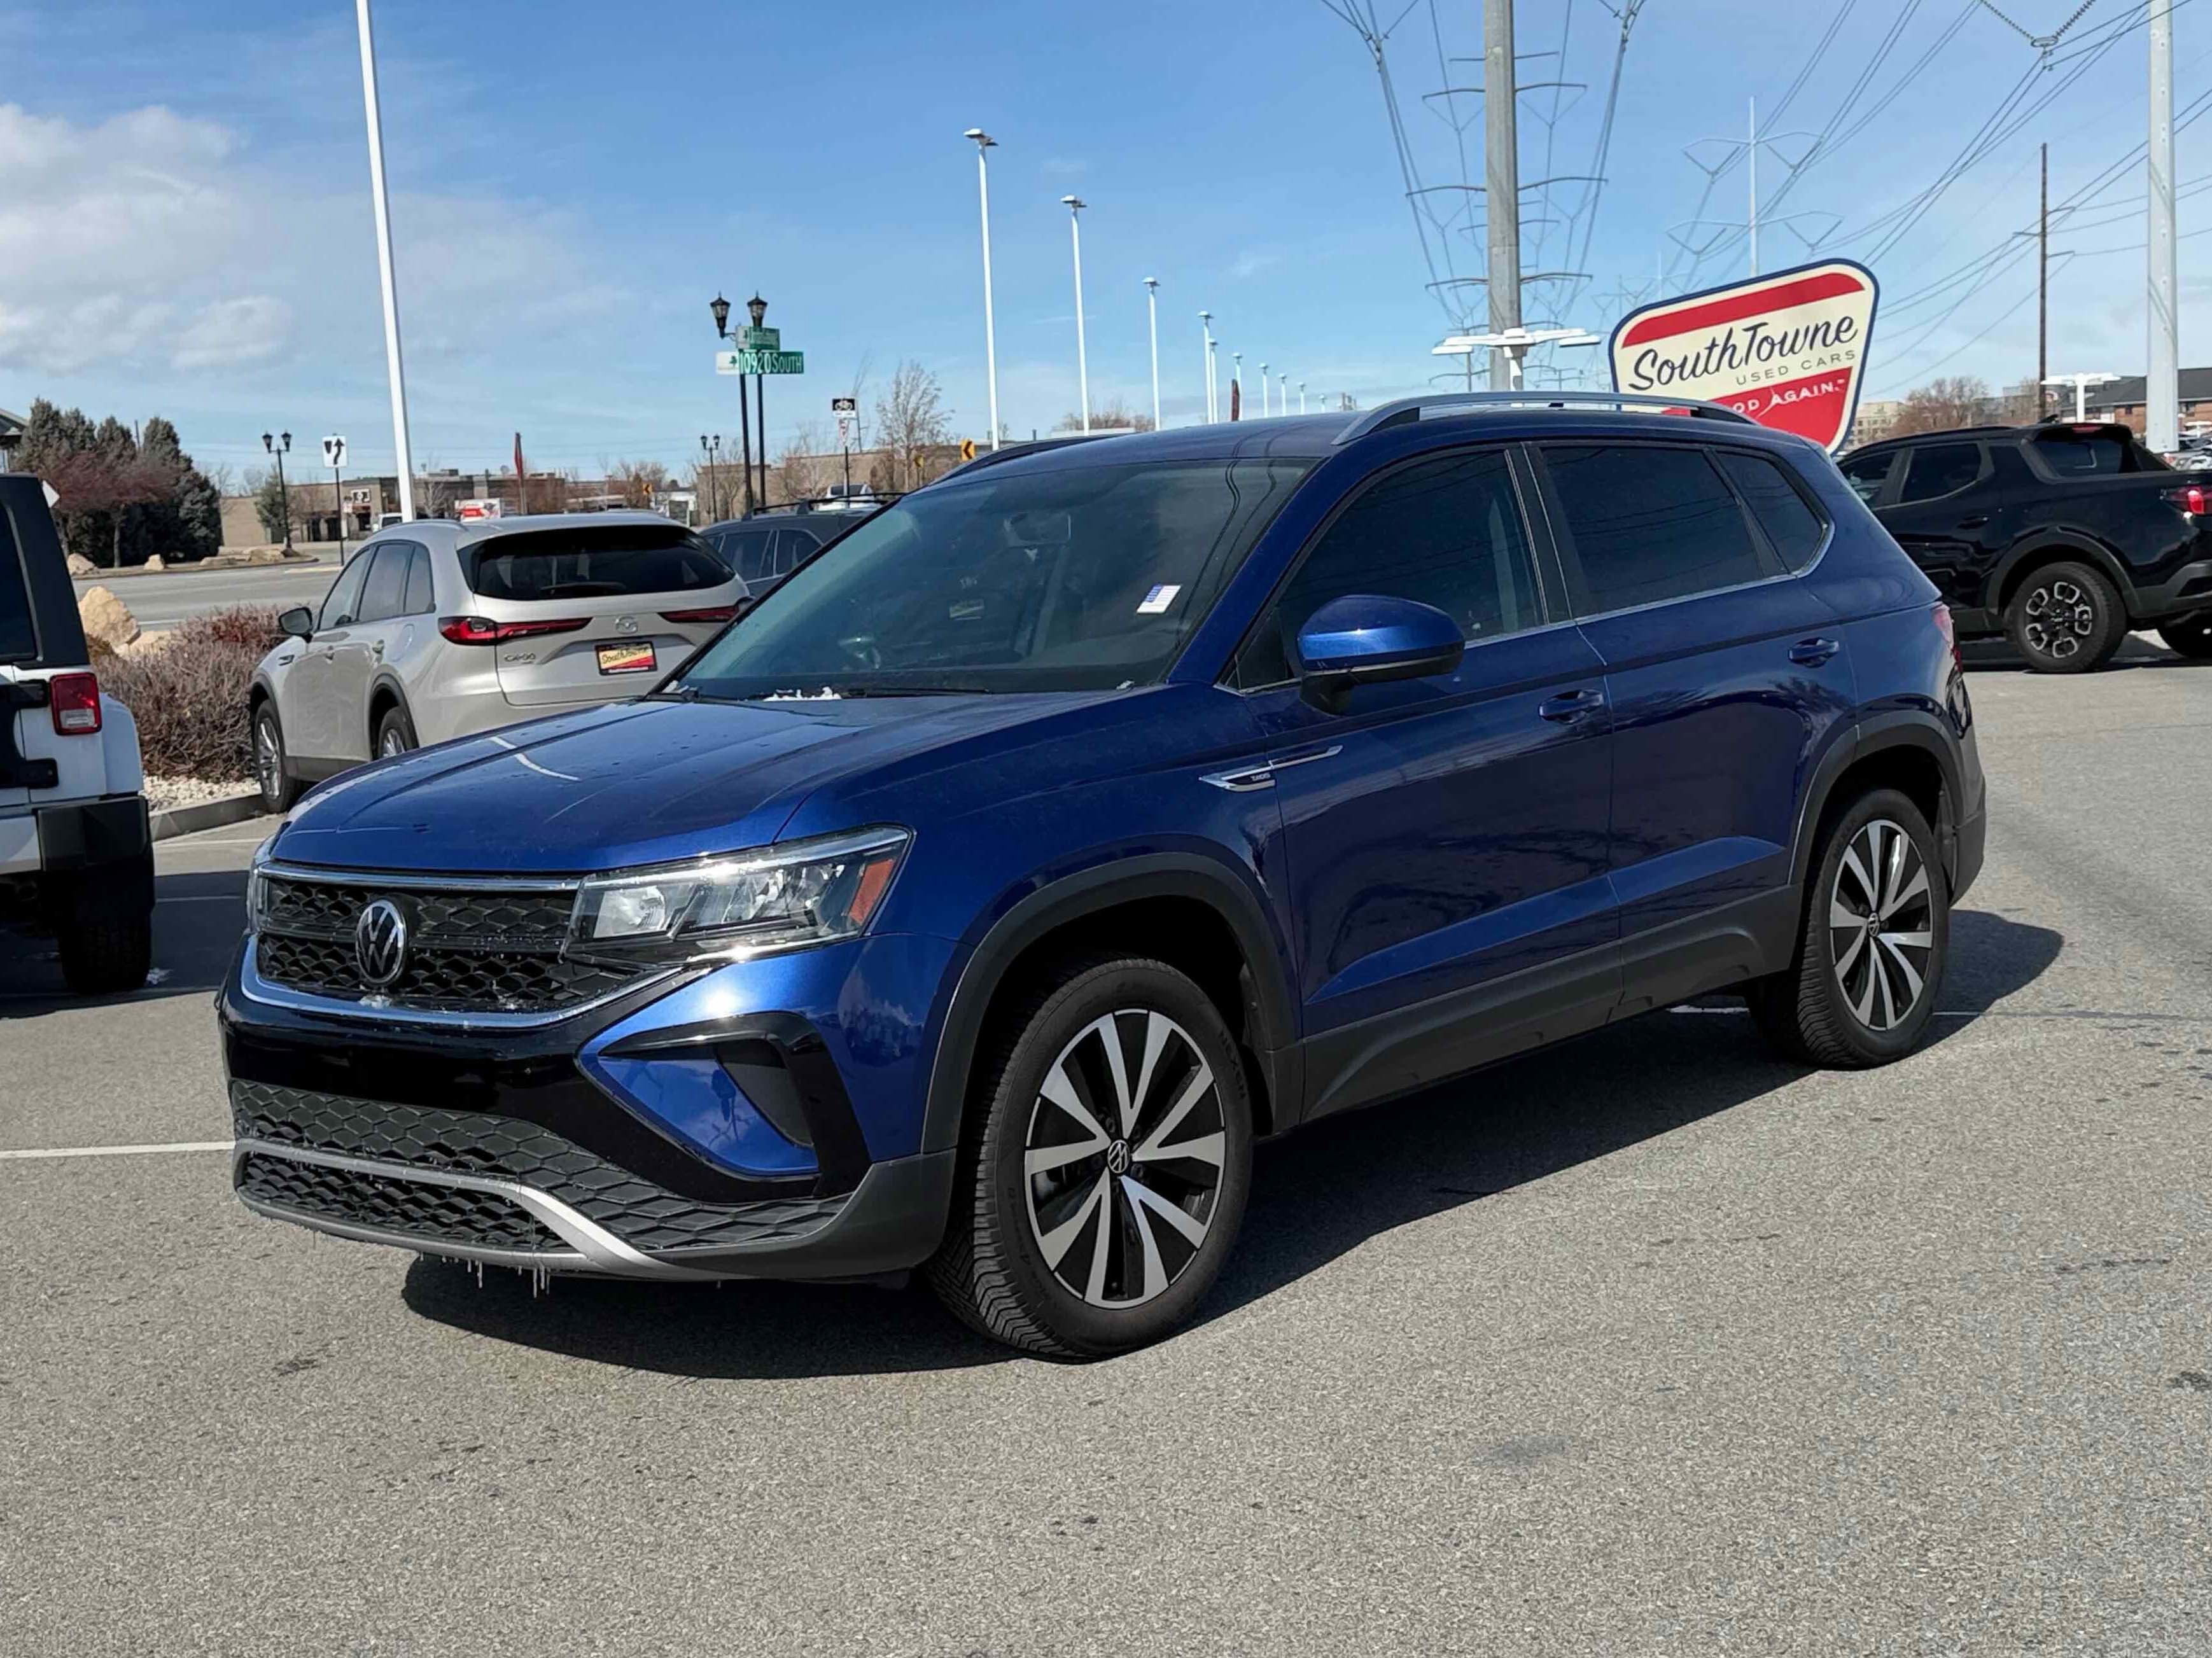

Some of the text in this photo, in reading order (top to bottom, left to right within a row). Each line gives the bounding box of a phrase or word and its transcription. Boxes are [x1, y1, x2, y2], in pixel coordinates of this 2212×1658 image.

[739, 352, 771, 374] 10920
[1628, 316, 1858, 391] SouthTowne
[1735, 350, 1856, 386] USED CARS
